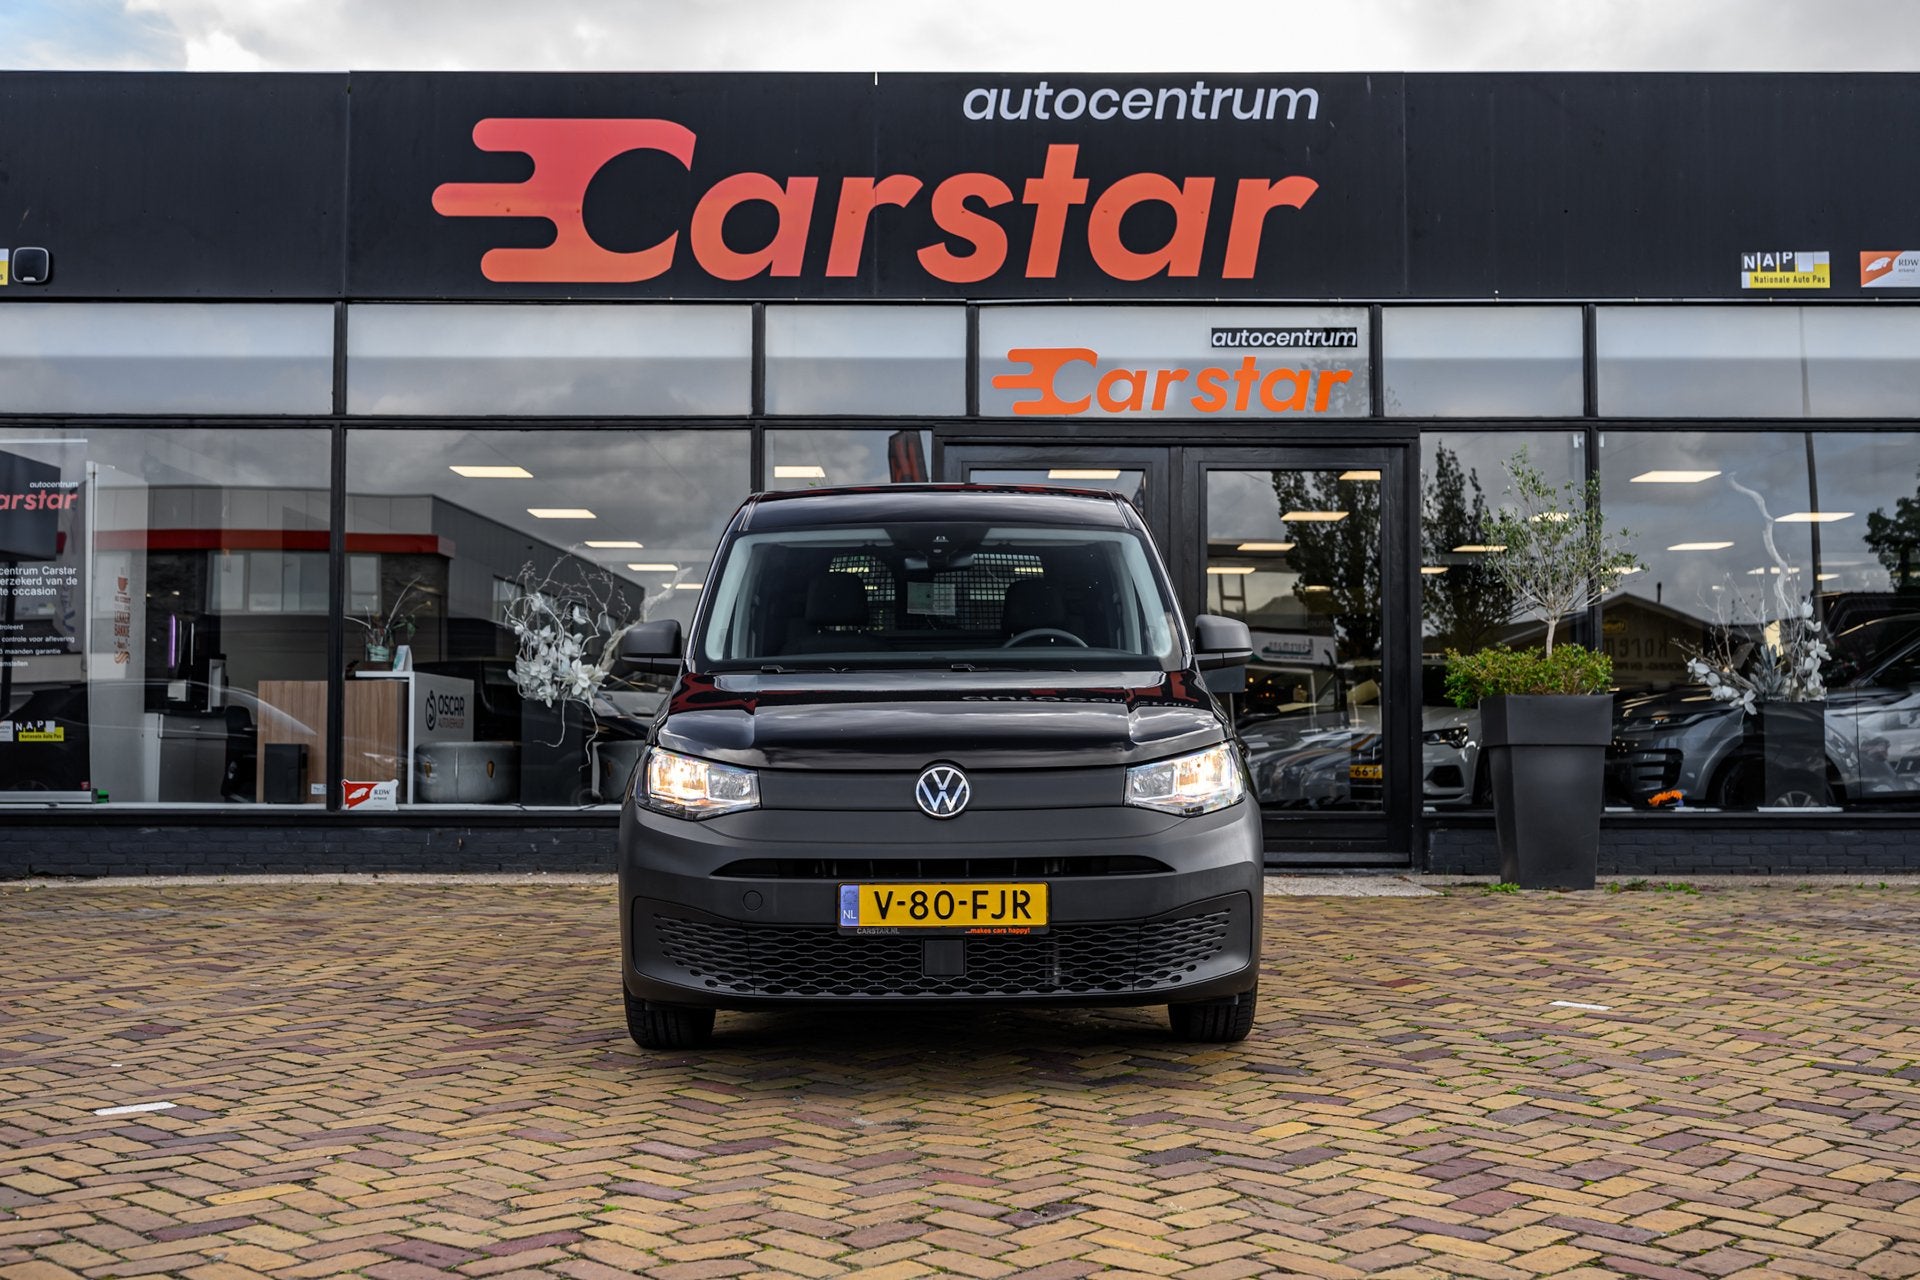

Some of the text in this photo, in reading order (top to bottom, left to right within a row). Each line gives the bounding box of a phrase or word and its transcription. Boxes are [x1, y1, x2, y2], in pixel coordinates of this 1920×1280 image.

[963, 81, 1319, 122] autocentrum
[431, 117, 1319, 283] Carstar
[1812, 275, 1826, 283] Pas
[1212, 329, 1357, 346] autocentrum
[992, 348, 1354, 415] Carstar
[42, 565, 77, 575] Carstar
[66, 577, 78, 585] de
[12, 587, 57, 596] occasion
[438, 695, 465, 717] OSCAR
[874, 890, 1032, 920] V-80-FJR
[843, 909, 857, 919] NL
